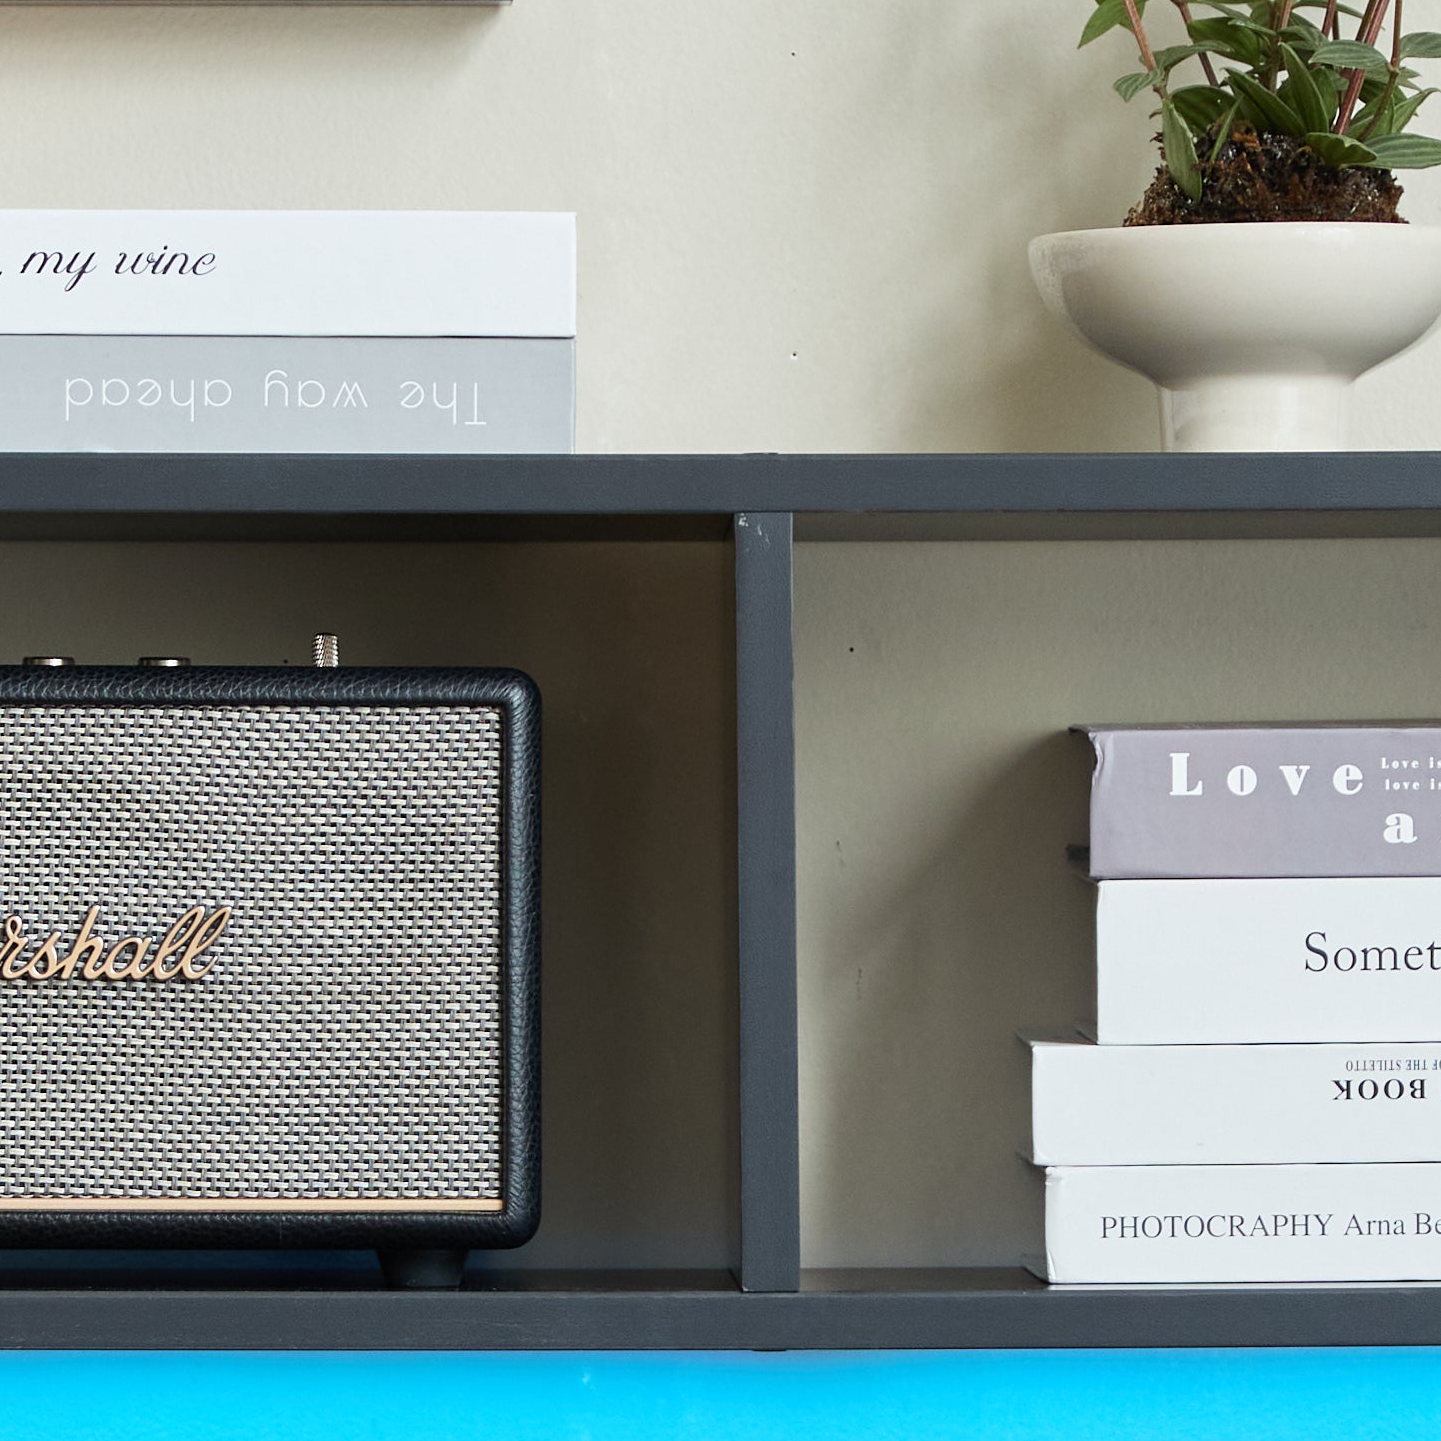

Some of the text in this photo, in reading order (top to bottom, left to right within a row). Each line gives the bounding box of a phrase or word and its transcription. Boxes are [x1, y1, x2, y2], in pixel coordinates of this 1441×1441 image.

[20, 244, 98, 292] my
[114, 243, 218, 276] wine
[64, 370, 487, 426] The way ahead
[1381, 757, 1419, 769] Love
[1169, 752, 1363, 796] Love
[1386, 779, 1420, 790] love
[1345, 1059, 1401, 1072] STILETTO
[1406, 1059, 1427, 1071] THE
[1331, 1079, 1427, 1100] BOOK
[1344, 1214, 1405, 1236] Arna
